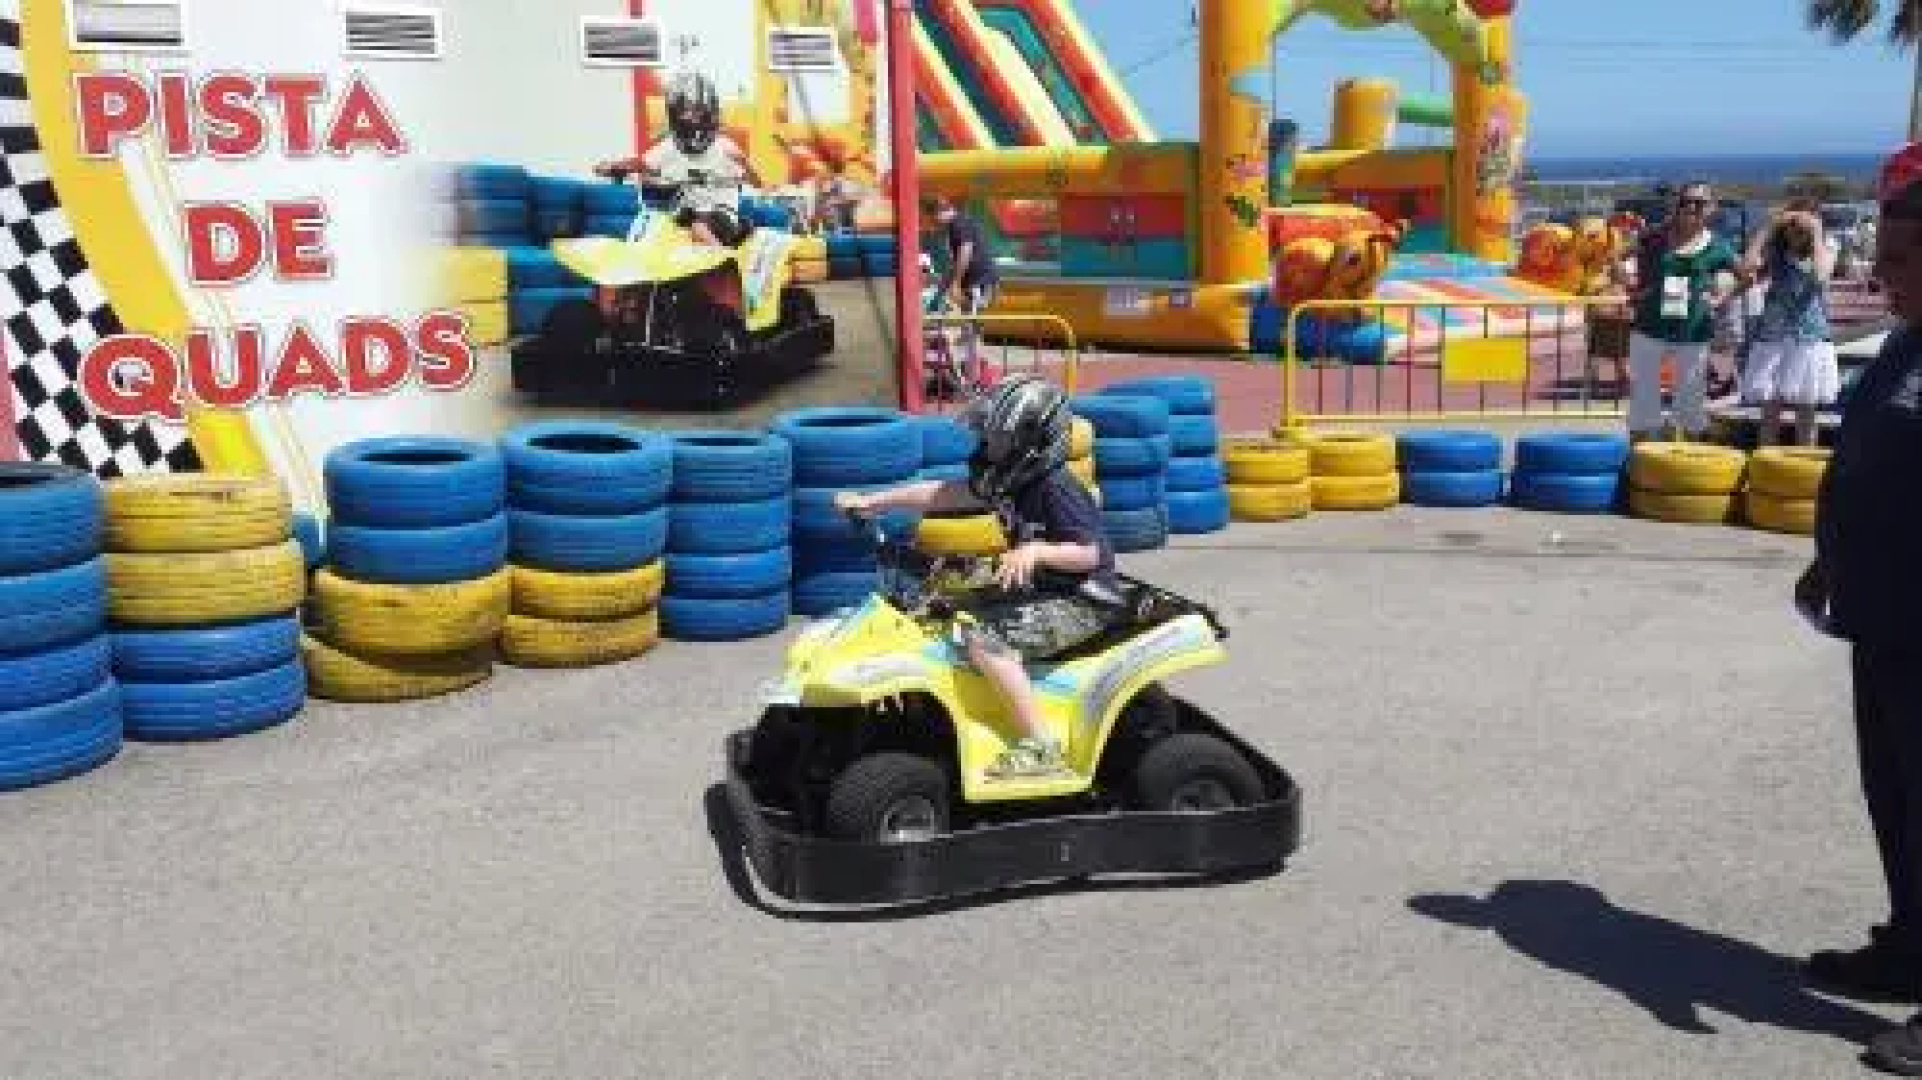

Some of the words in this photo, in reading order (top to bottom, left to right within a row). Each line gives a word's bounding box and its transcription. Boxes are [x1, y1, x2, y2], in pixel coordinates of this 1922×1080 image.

[75, 73, 406, 157] PISTA
[183, 199, 333, 283] DE
[80, 312, 475, 420] QUADS
